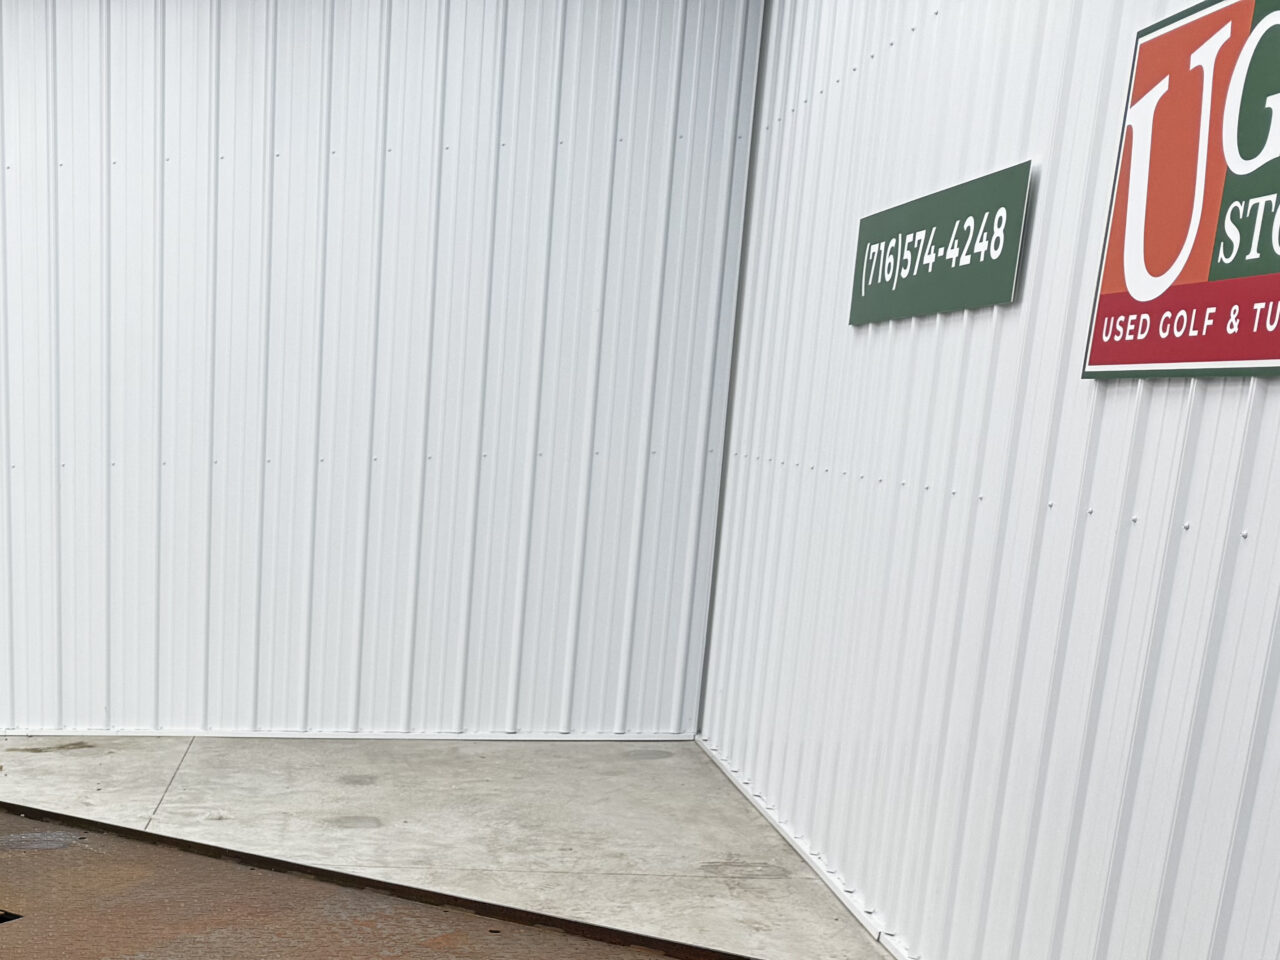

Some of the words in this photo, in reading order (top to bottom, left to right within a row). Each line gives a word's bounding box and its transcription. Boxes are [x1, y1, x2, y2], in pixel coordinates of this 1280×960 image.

[861, 206, 1007, 297] (716)574-4248
[1102, 313, 1151, 342] USED
[1158, 307, 1217, 339] GOLF
[1226, 304, 1240, 335] &
